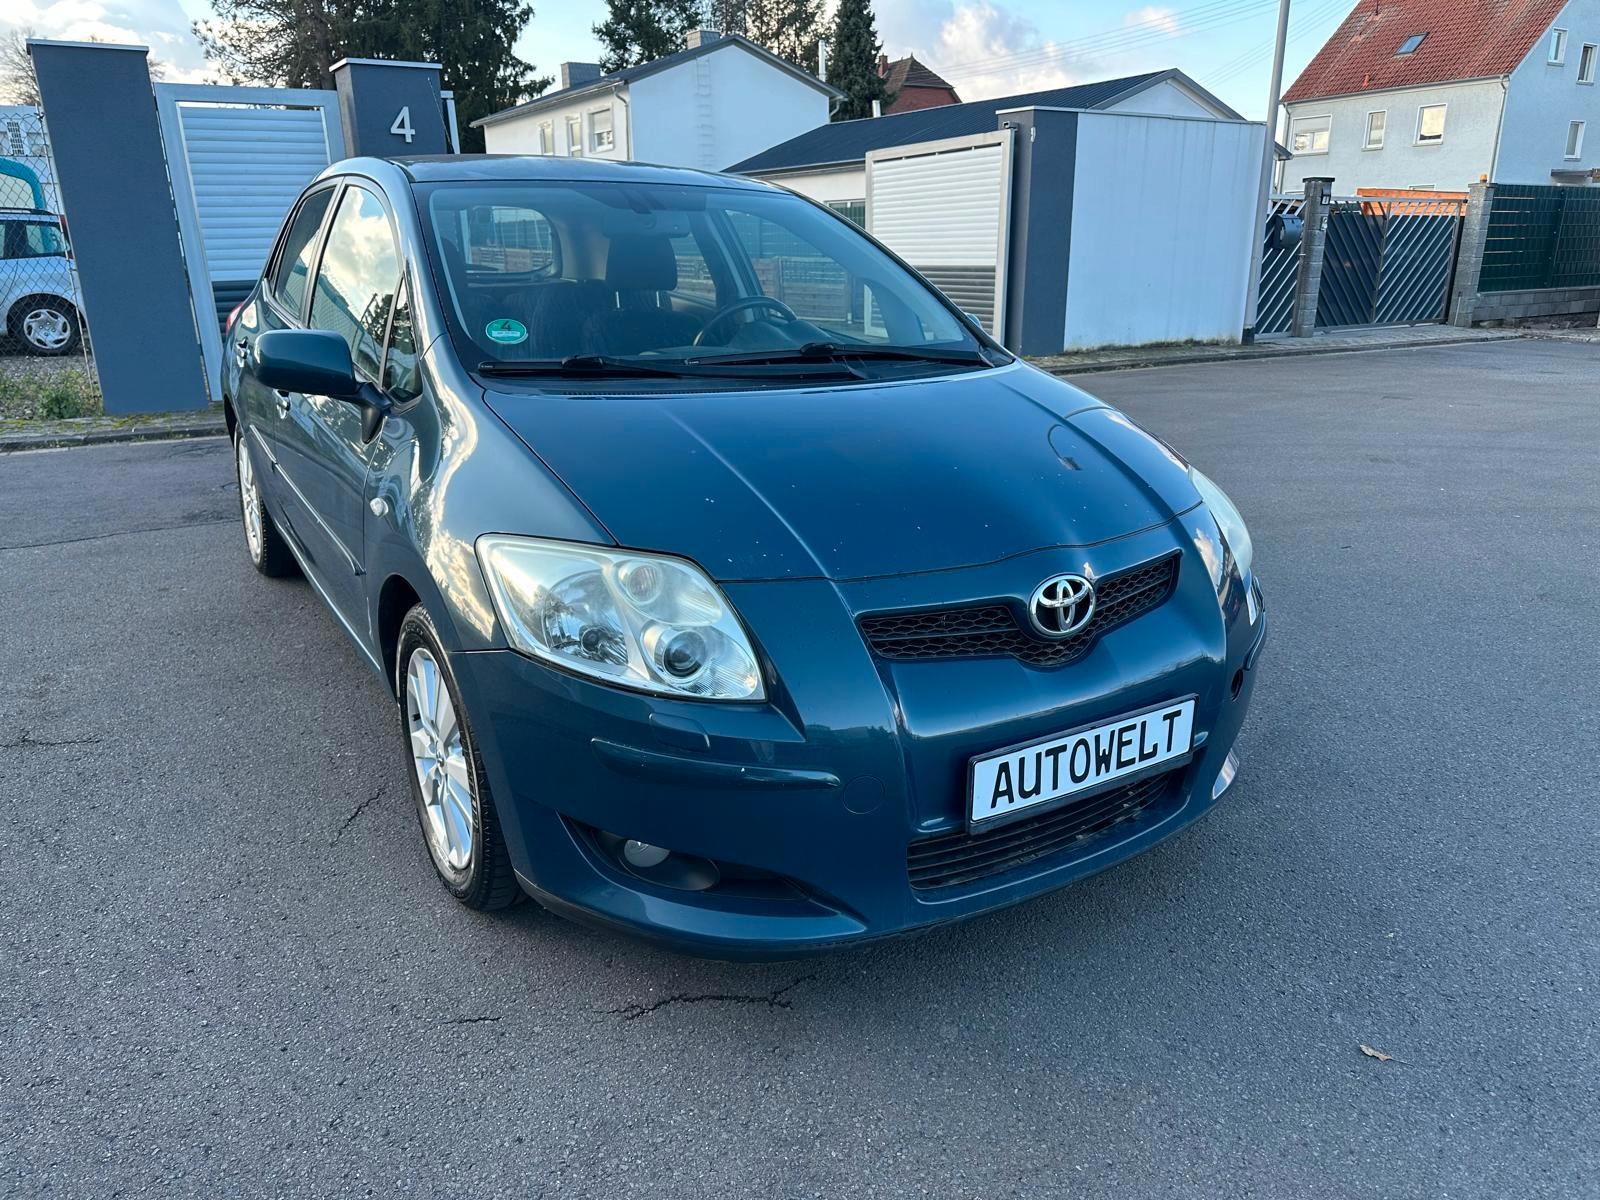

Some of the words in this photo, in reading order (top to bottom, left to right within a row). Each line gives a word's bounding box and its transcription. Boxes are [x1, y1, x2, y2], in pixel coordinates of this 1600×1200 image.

[391, 106, 415, 142] 4
[501, 320, 512, 331] 4
[990, 709, 1182, 809] AUTOWELT
